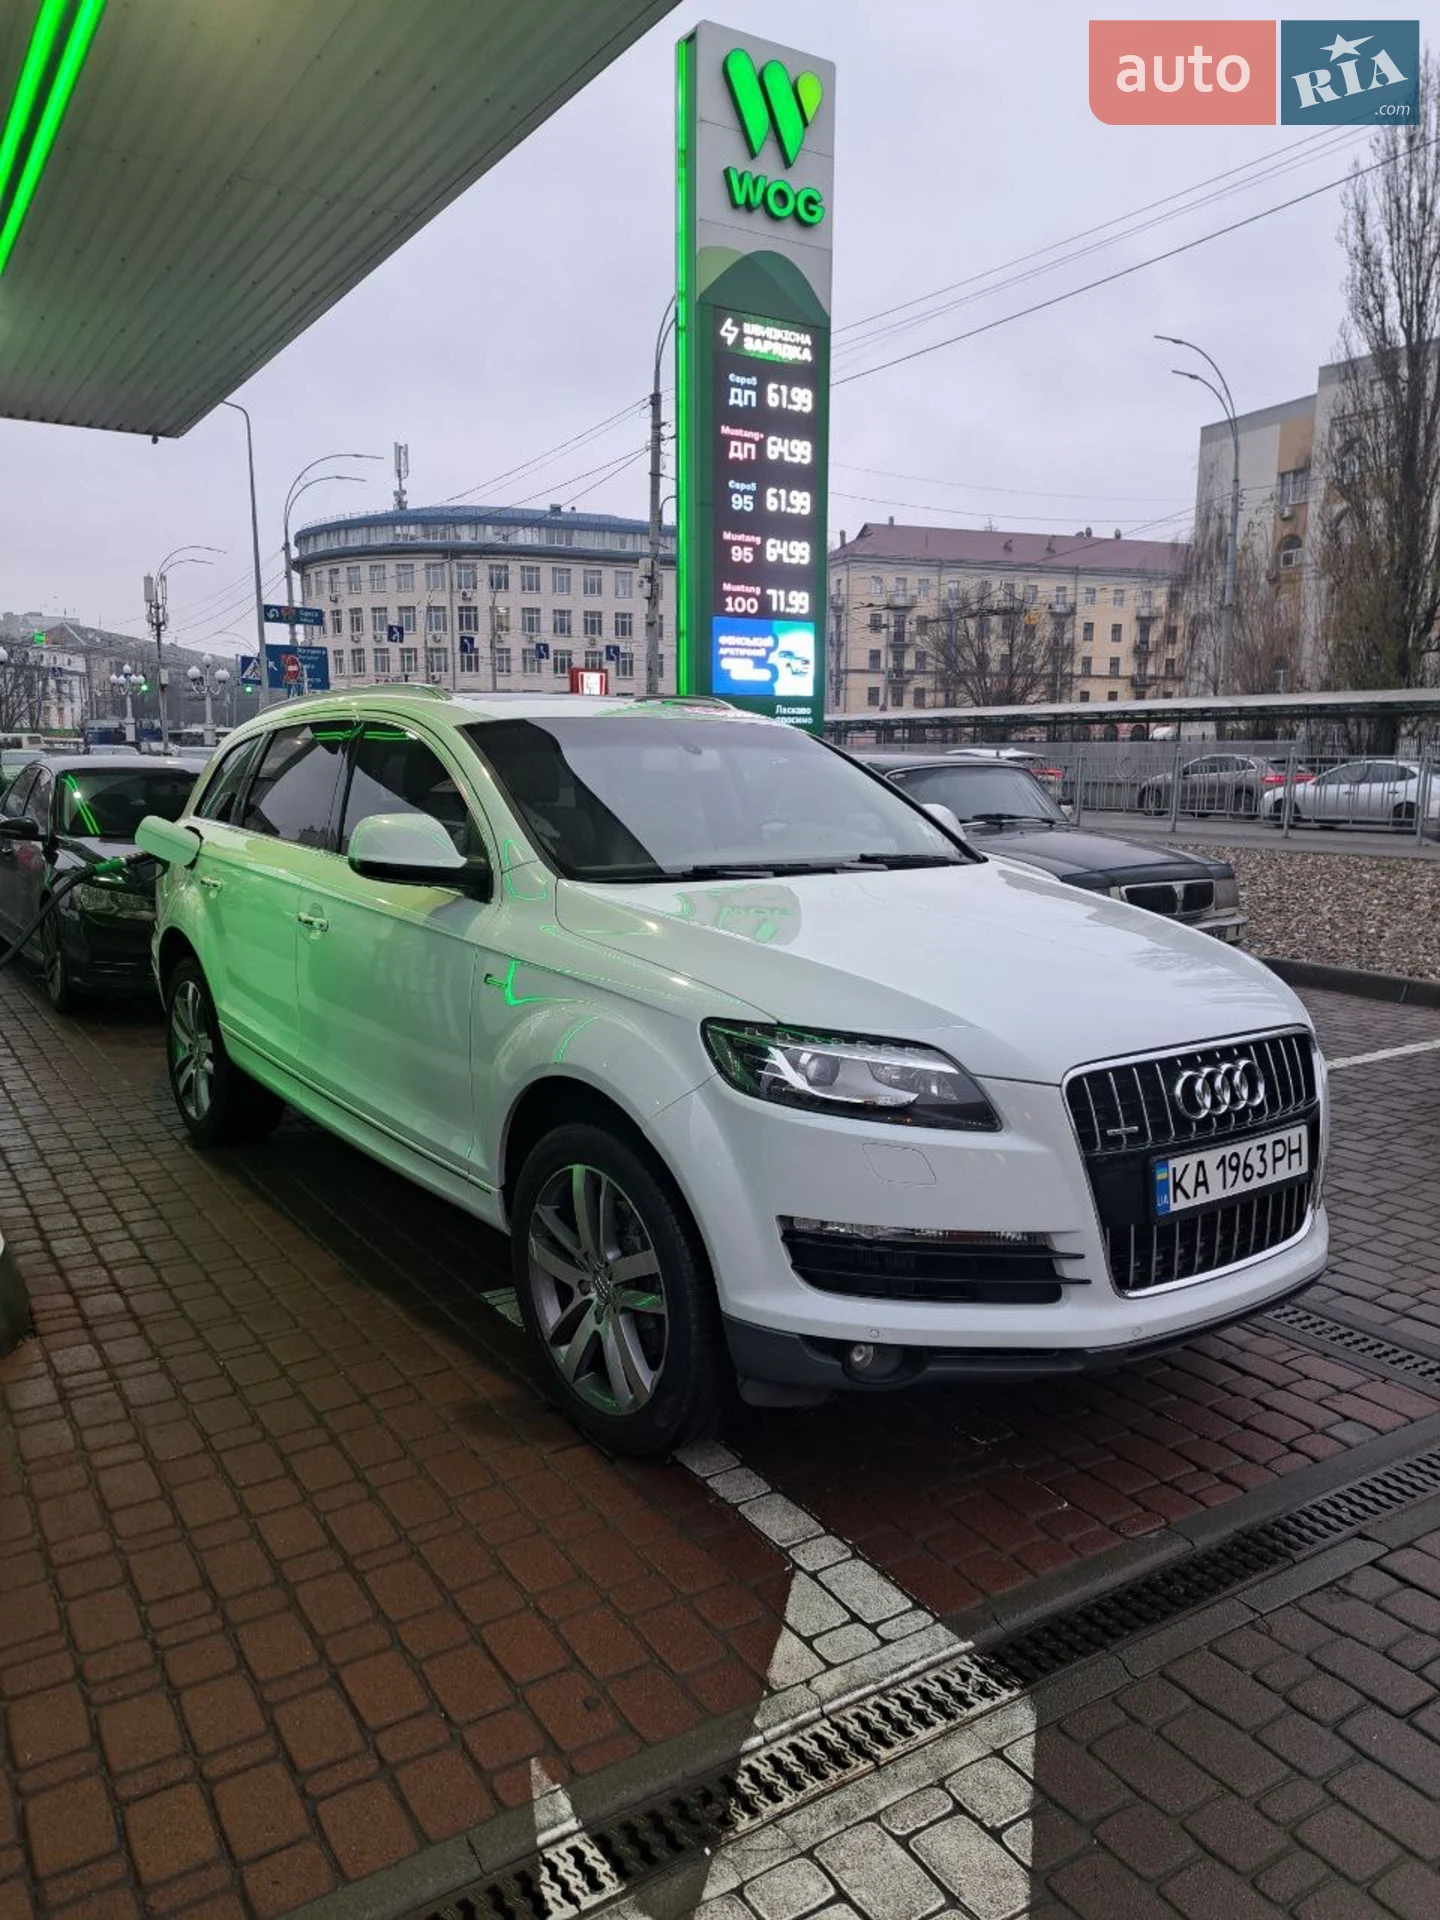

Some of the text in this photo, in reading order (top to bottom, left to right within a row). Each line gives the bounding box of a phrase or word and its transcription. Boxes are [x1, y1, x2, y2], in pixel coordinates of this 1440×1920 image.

[723, 166, 825, 227] WOG
[728, 383, 813, 413] ДП 61.99
[728, 436, 812, 465] ДП 64.99
[731, 487, 811, 515] 95 61.99
[722, 531, 761, 545] Mustang
[731, 538, 810, 565] 95 64.99
[722, 582, 761, 596] Mustang
[725, 589, 810, 614] 100 71.99
[1172, 1132, 1302, 1203] KA 1963 PH
